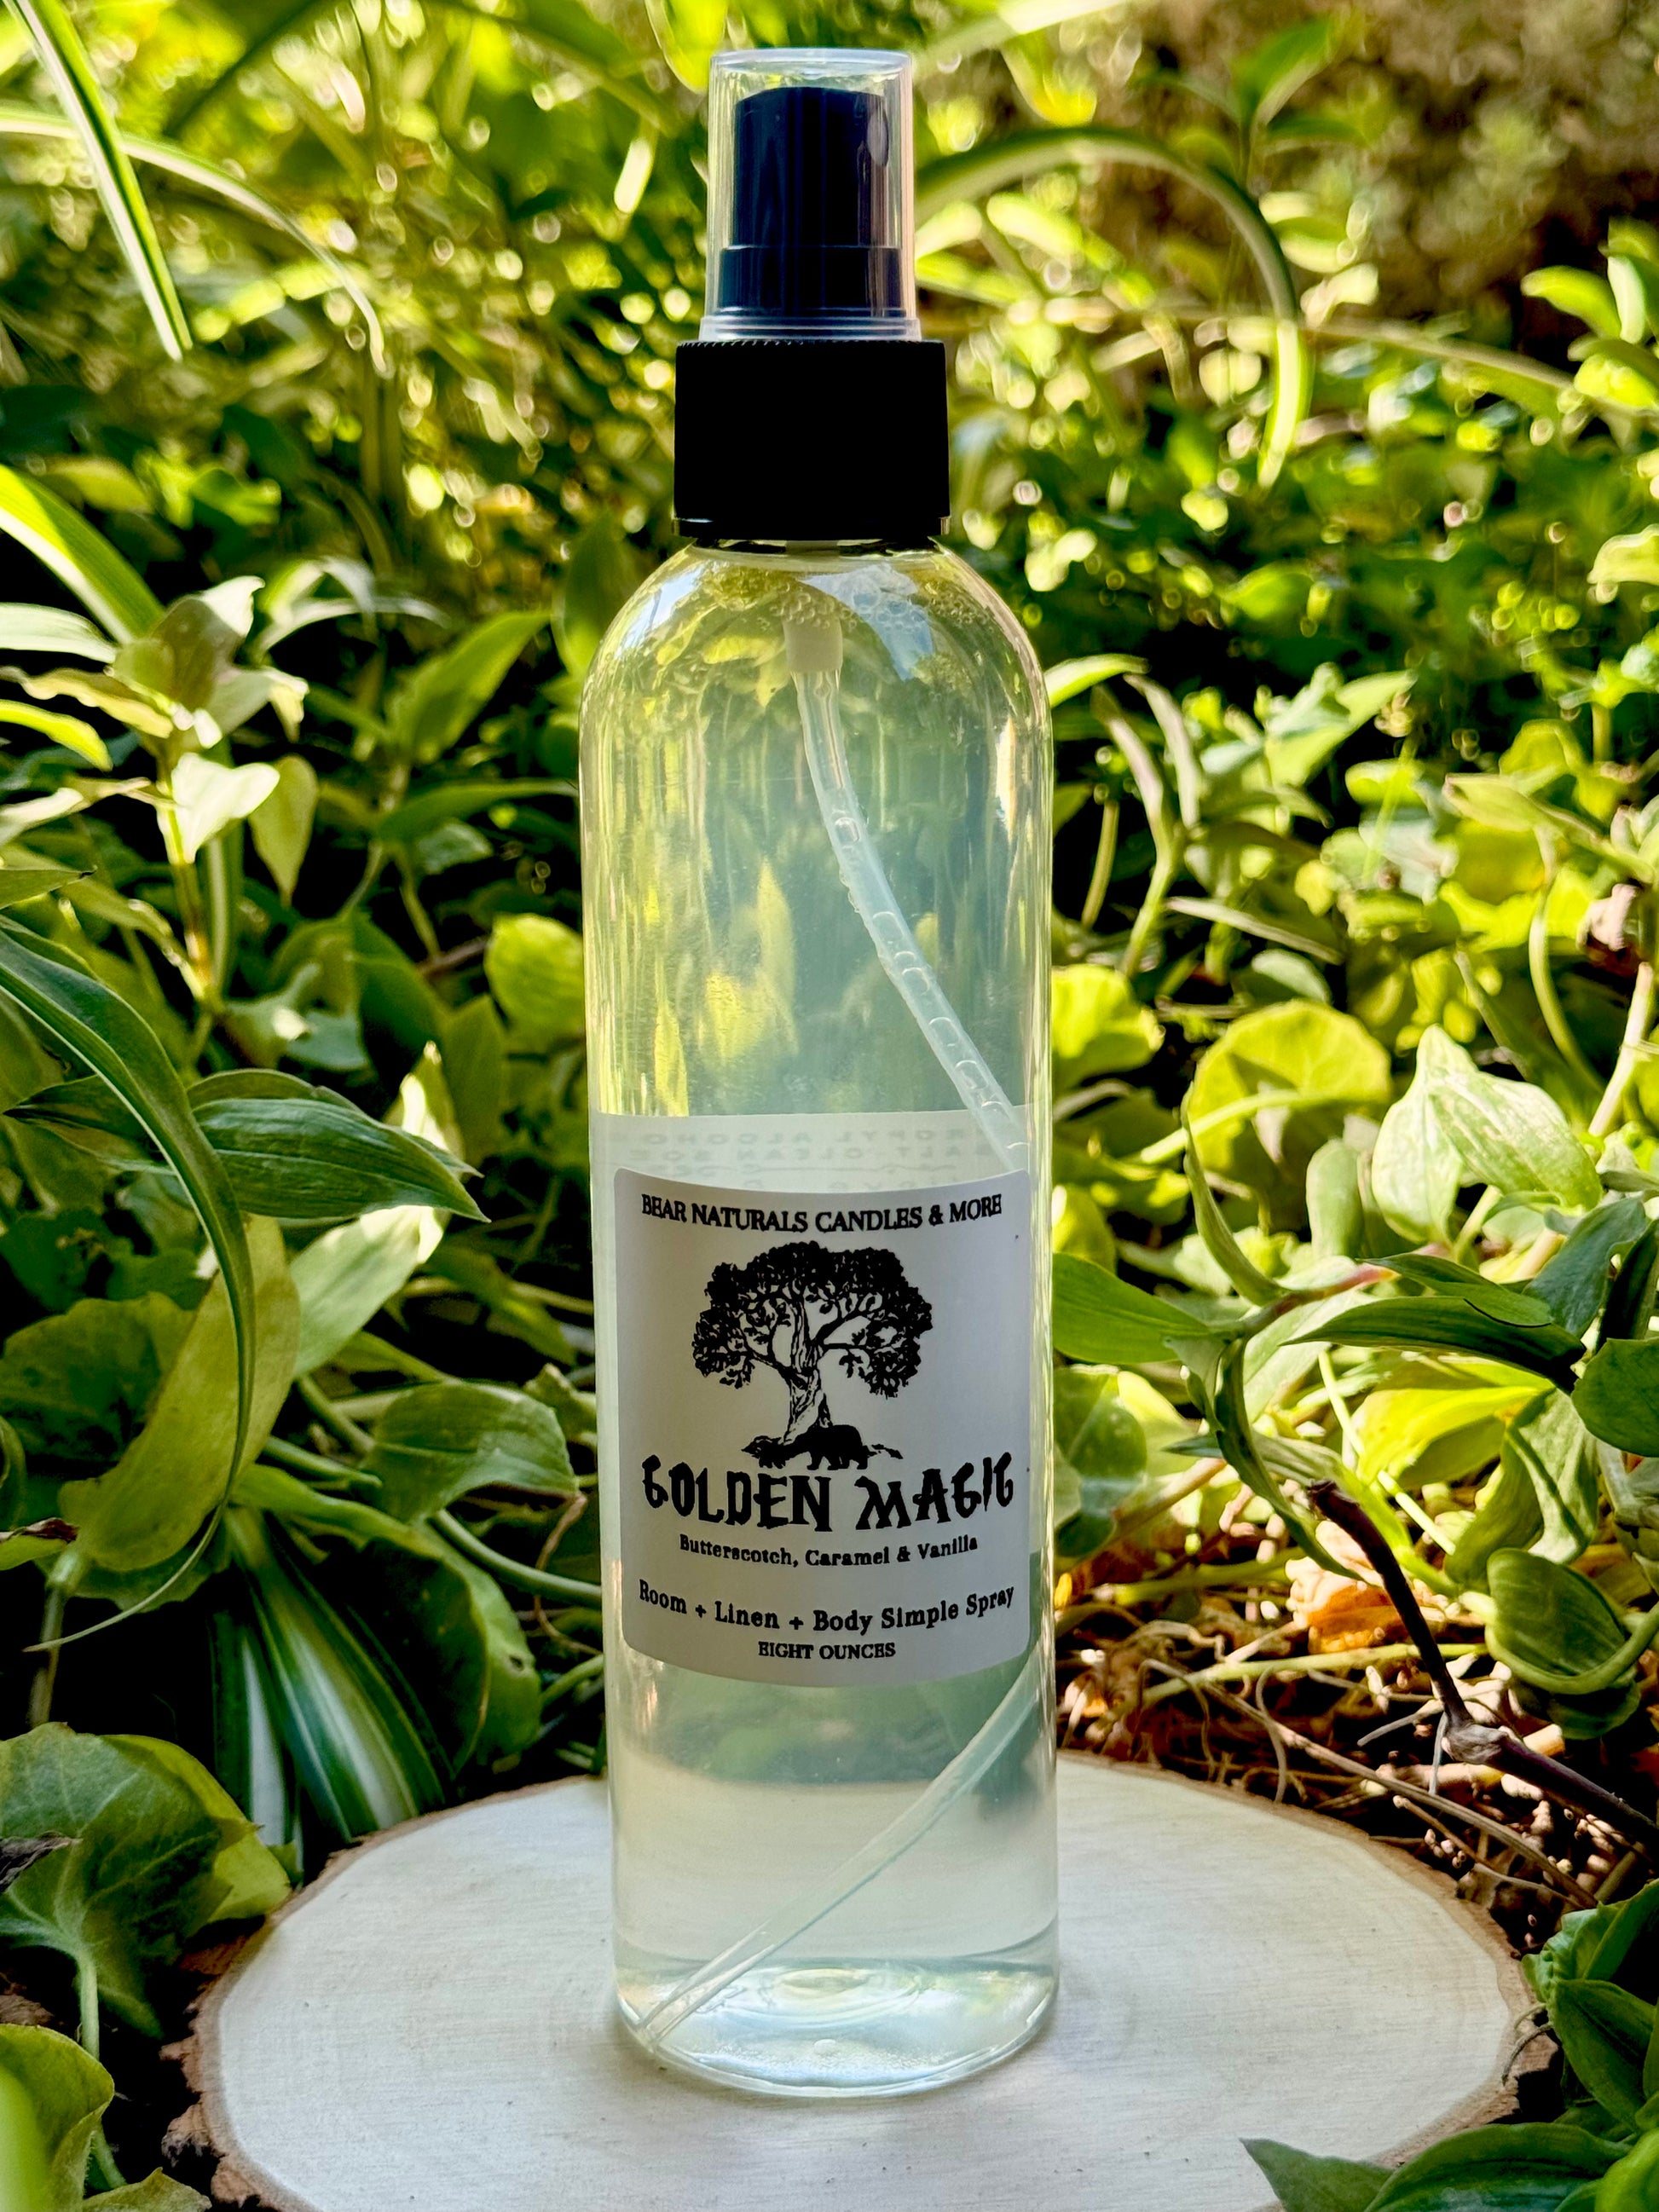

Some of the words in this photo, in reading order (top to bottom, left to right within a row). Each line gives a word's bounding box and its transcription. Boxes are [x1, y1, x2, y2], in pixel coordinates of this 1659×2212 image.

[641, 1193, 687, 1224] BEAR
[691, 1203, 808, 1233] NATURALS
[815, 1205, 923, 1234] CANDLES
[928, 1204, 945, 1227] &
[949, 1193, 1003, 1223] MORE
[641, 1454, 833, 1533] GOLDEN
[854, 1452, 1014, 1531] MAGIC
[679, 1533, 799, 1568] Butterscotch,
[805, 1546, 891, 1568] Caramel
[896, 1545, 911, 1563] &
[916, 1533, 978, 1561] Vanilla
[639, 1578, 688, 1615] Room
[695, 1603, 708, 1619] +
[714, 1600, 781, 1631] Linen
[789, 1616, 805, 1632] +
[812, 1609, 873, 1637] Body
[881, 1599, 959, 1630] Simple
[965, 1585, 1014, 1618] Spray
[757, 1640, 815, 1660] EIGHT
[818, 1642, 897, 1661] OUNCES
